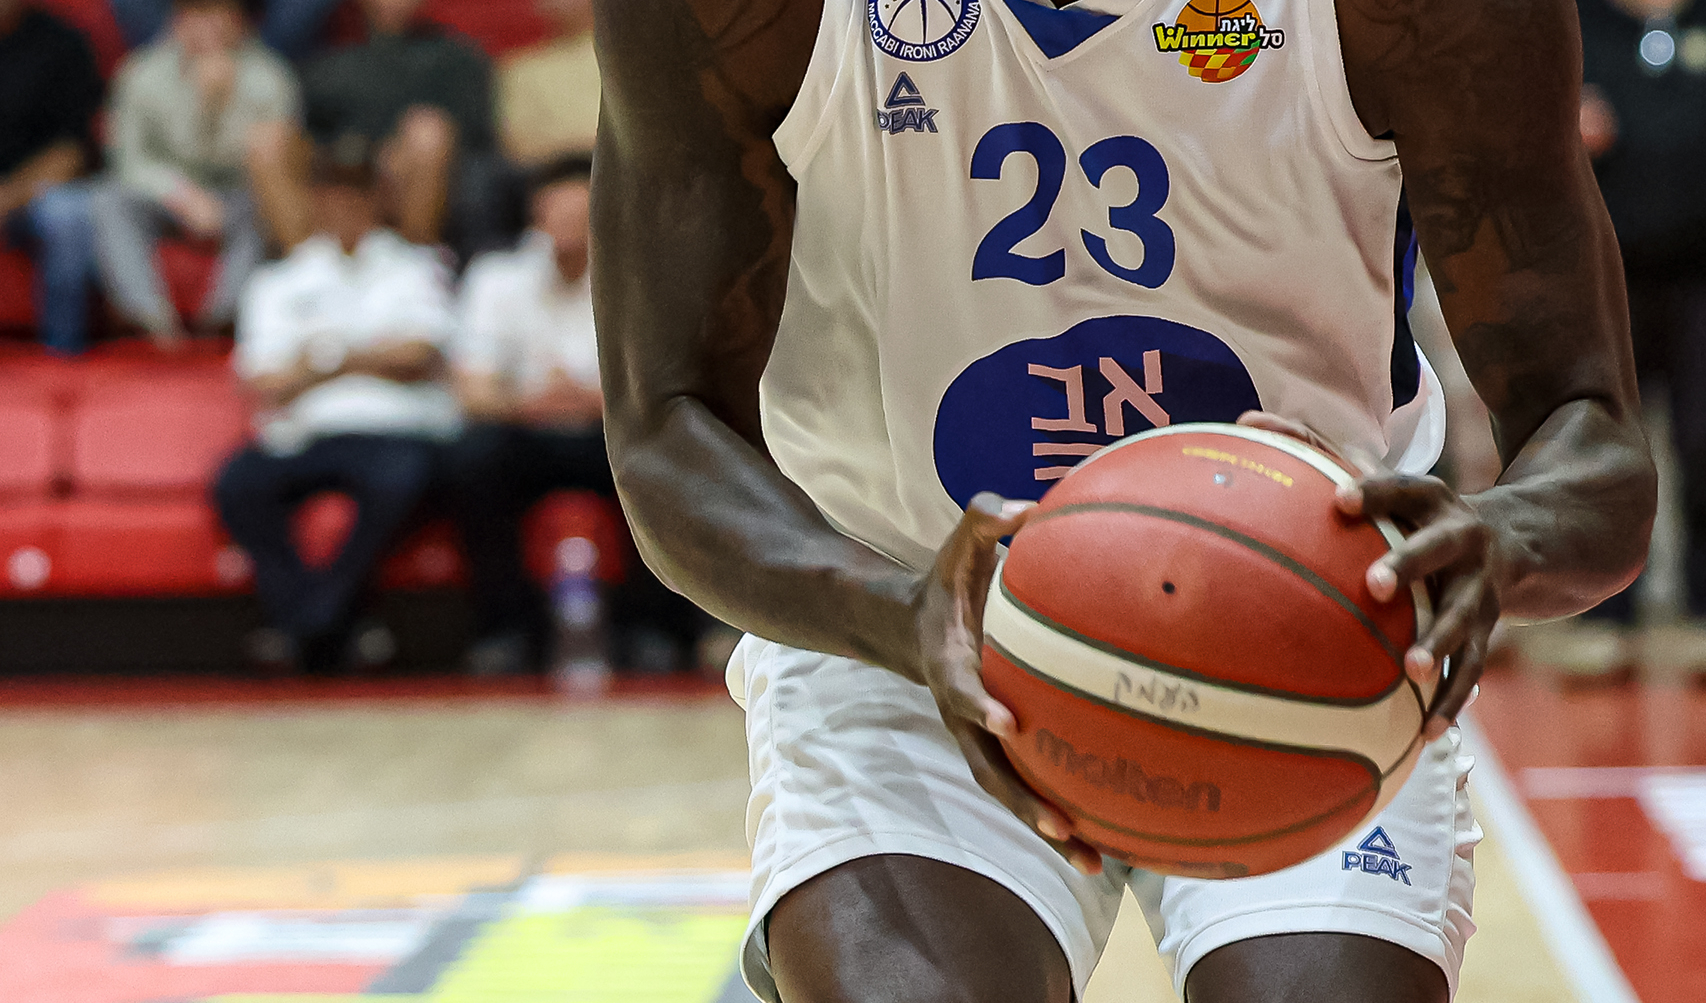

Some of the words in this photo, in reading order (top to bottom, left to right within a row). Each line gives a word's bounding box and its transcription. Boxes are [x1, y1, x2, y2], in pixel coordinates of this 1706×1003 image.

[868, 2, 900, 53] MACCABI
[900, 43, 937, 59] IRONI
[937, 1, 980, 55] RAANANA
[1155, 25, 1256, 50] Winner
[1259, 27, 1283, 47] סל
[1220, 14, 1256, 32] ליגת
[969, 121, 1176, 290] 23
[1035, 727, 1222, 812] molten
[1341, 851, 1412, 886] PEAK
